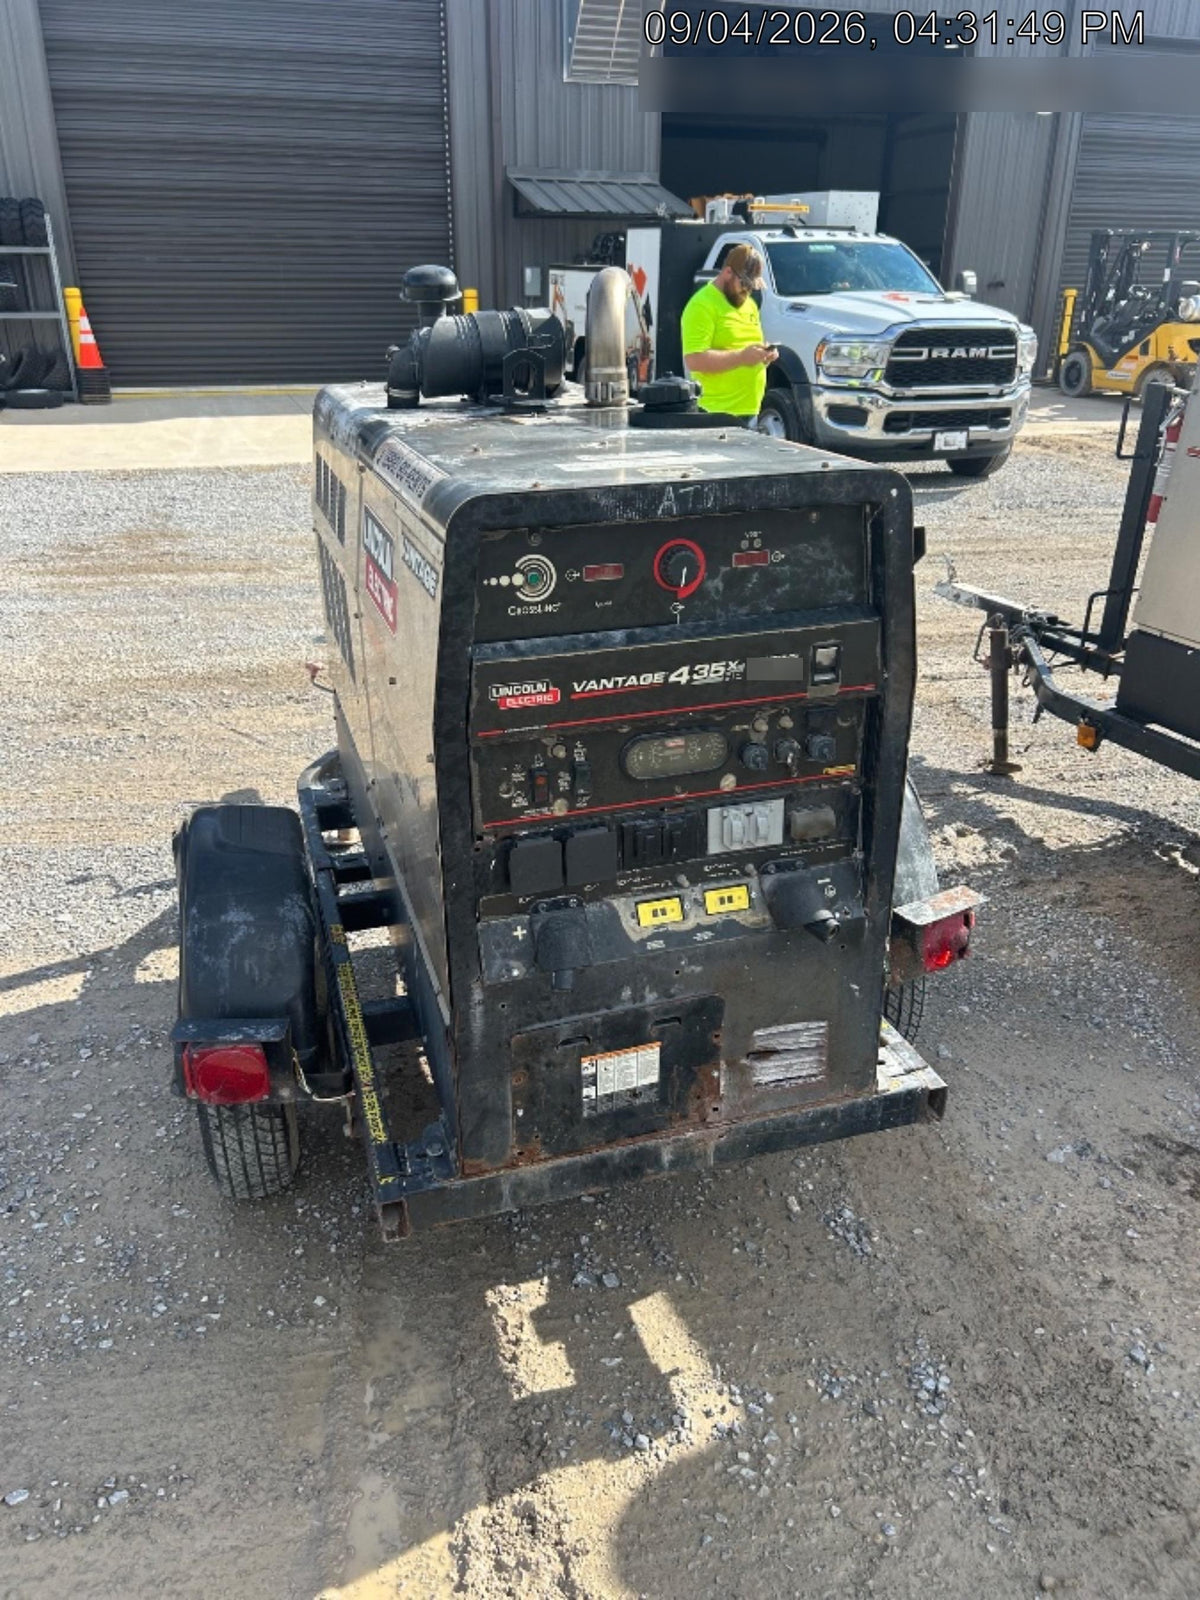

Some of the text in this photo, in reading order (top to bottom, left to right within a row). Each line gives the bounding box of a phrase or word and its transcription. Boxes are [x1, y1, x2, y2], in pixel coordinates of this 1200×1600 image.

[930, 347, 988, 359] RAM
[491, 682, 547, 698] LINCOLN
[572, 671, 667, 694] VANTAGE
[505, 693, 555, 707] ELECTRIC
